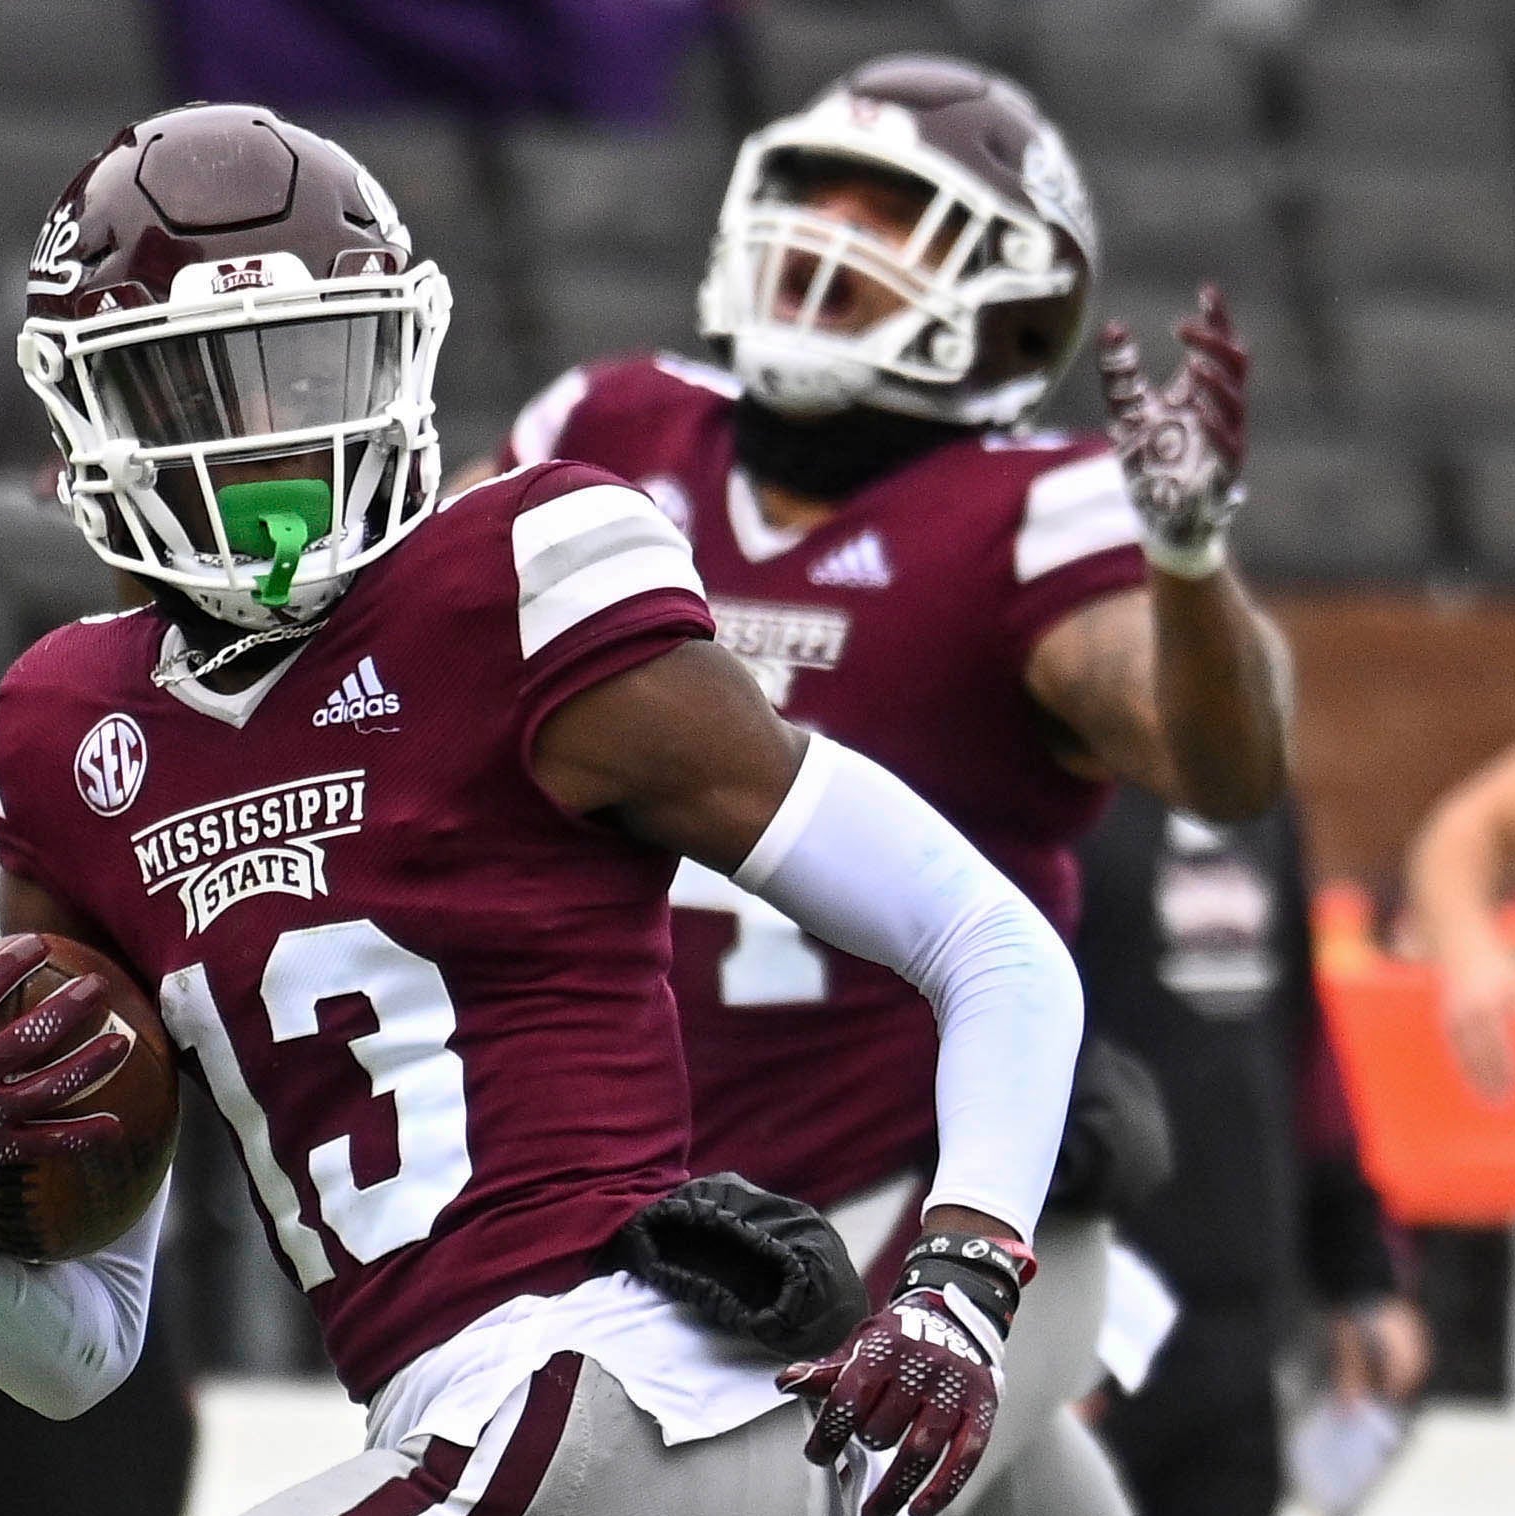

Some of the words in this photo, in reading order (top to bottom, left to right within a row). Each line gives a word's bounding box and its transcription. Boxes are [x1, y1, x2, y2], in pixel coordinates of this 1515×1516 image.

[222, 272, 262, 288] STATE
[312, 692, 401, 728] adidas
[80, 716, 141, 810] SEC
[133, 780, 366, 885] MISSISSIPPI
[202, 854, 302, 914] STATE
[159, 918, 474, 1293] 13
